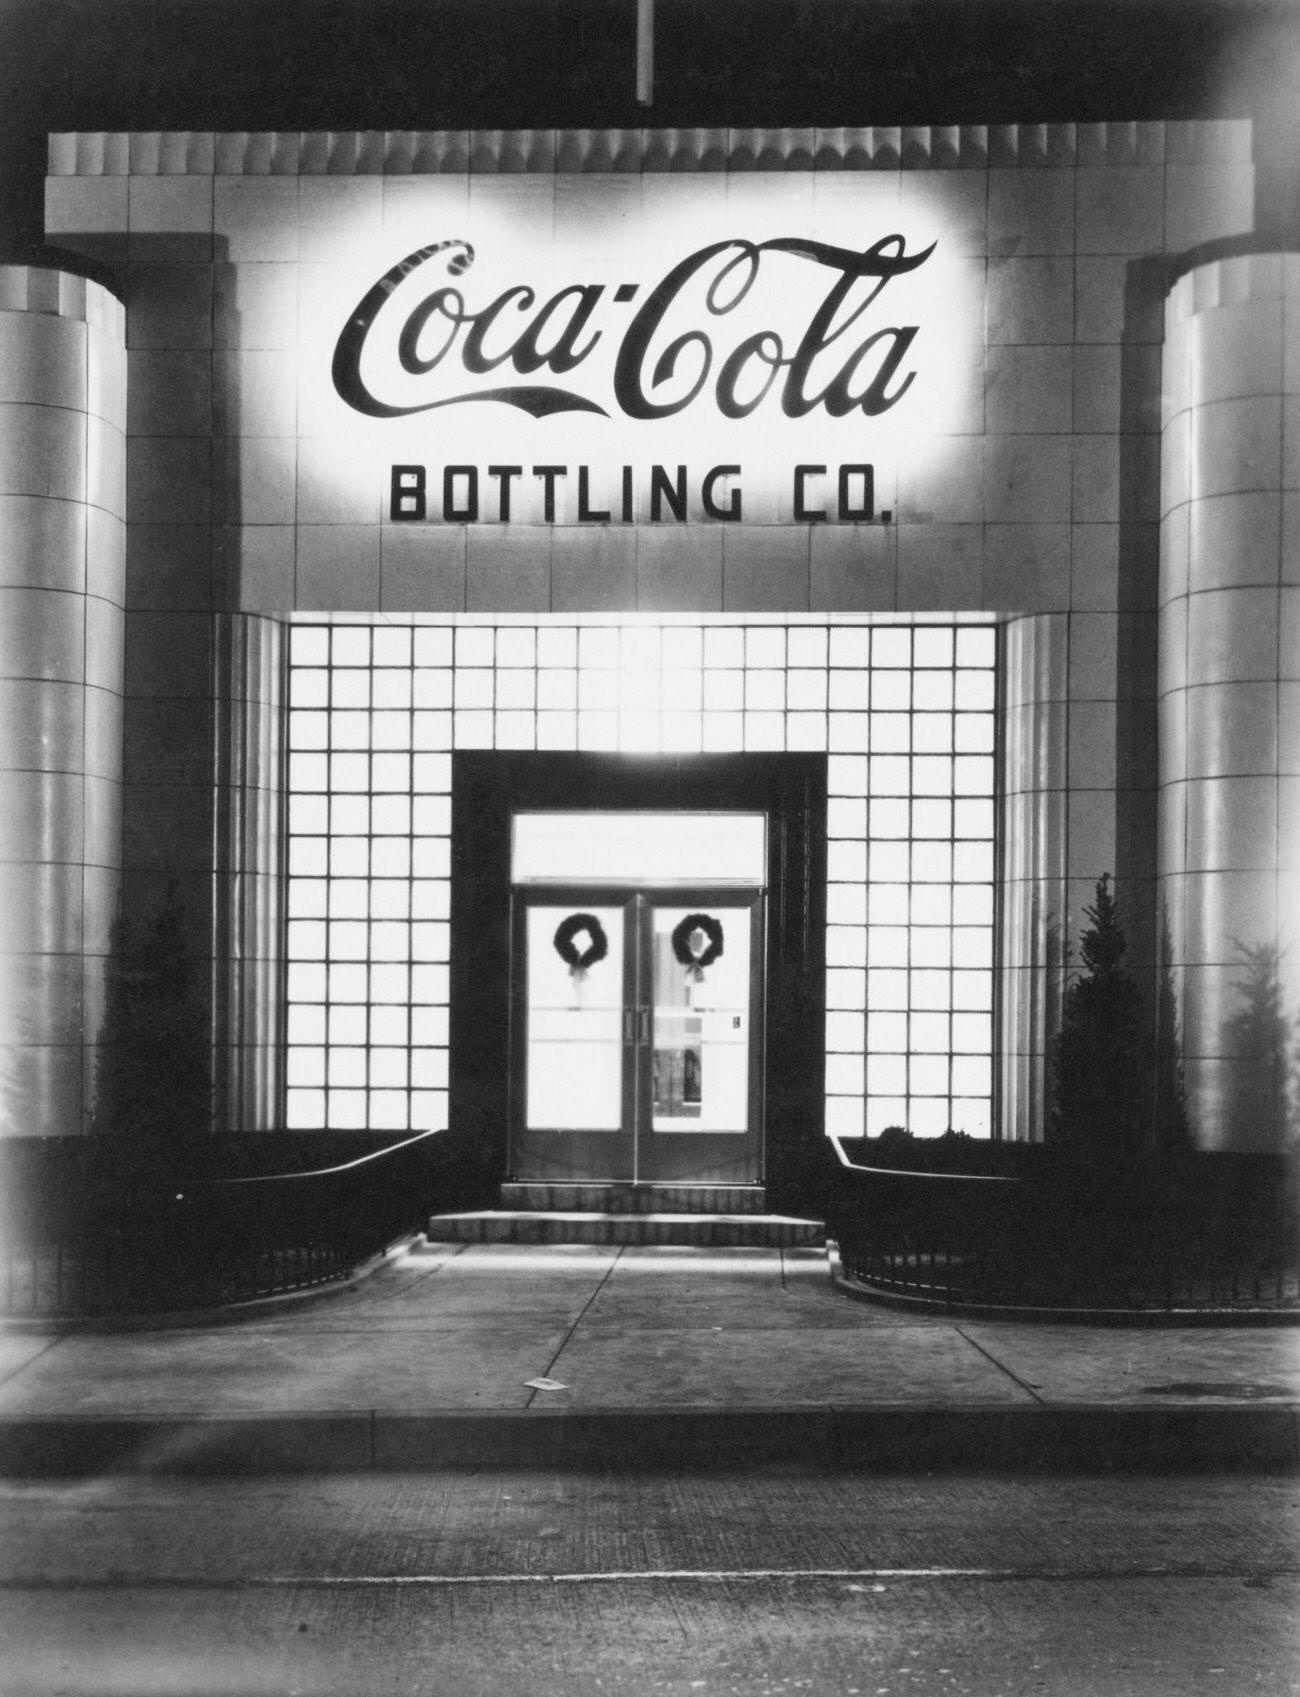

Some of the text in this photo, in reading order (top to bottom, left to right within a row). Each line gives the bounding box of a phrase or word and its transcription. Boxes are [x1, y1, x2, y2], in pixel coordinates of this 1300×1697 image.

[331, 234, 938, 420] Coca-Cola
[390, 463, 893, 524] BOTTLING CO.
